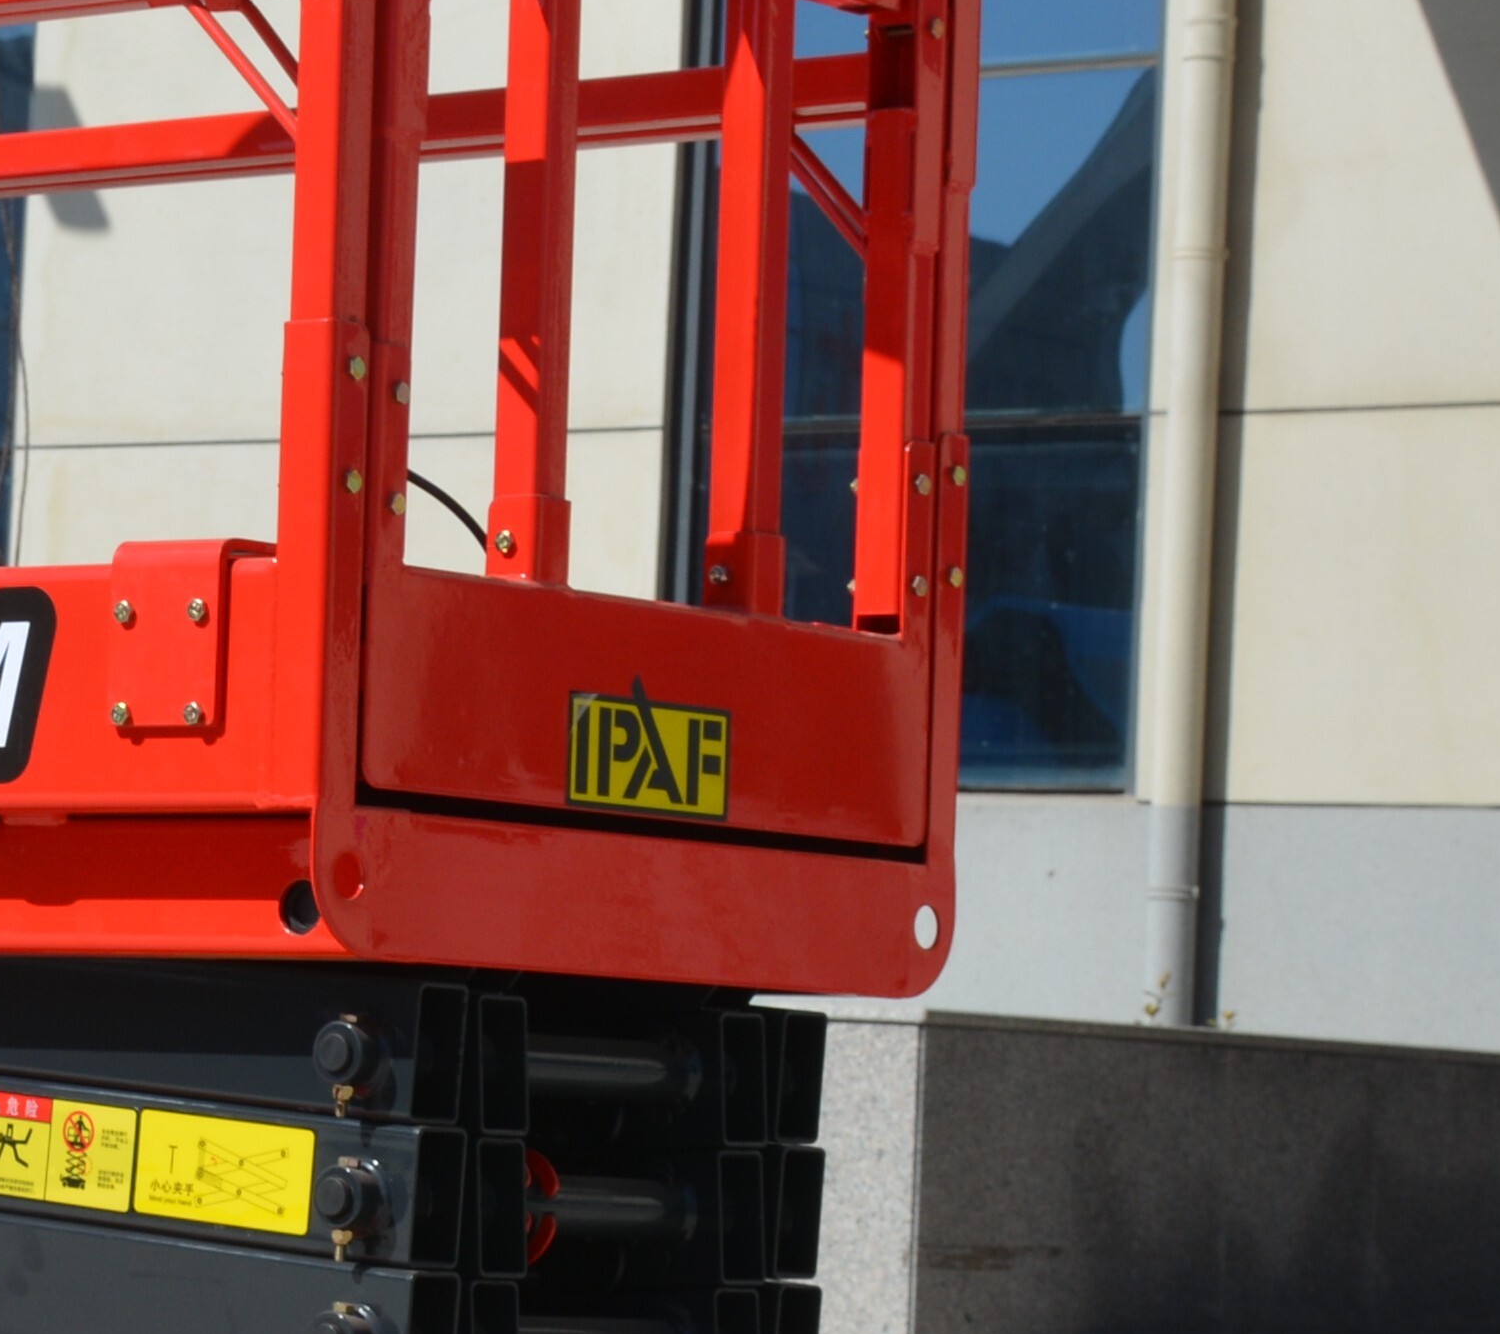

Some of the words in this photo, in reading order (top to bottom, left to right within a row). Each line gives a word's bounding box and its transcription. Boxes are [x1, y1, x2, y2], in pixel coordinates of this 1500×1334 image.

[573, 675, 722, 807] IPAF
[6, 1097, 39, 1118] 危险
[150, 1178, 194, 1196] 小心夹手
